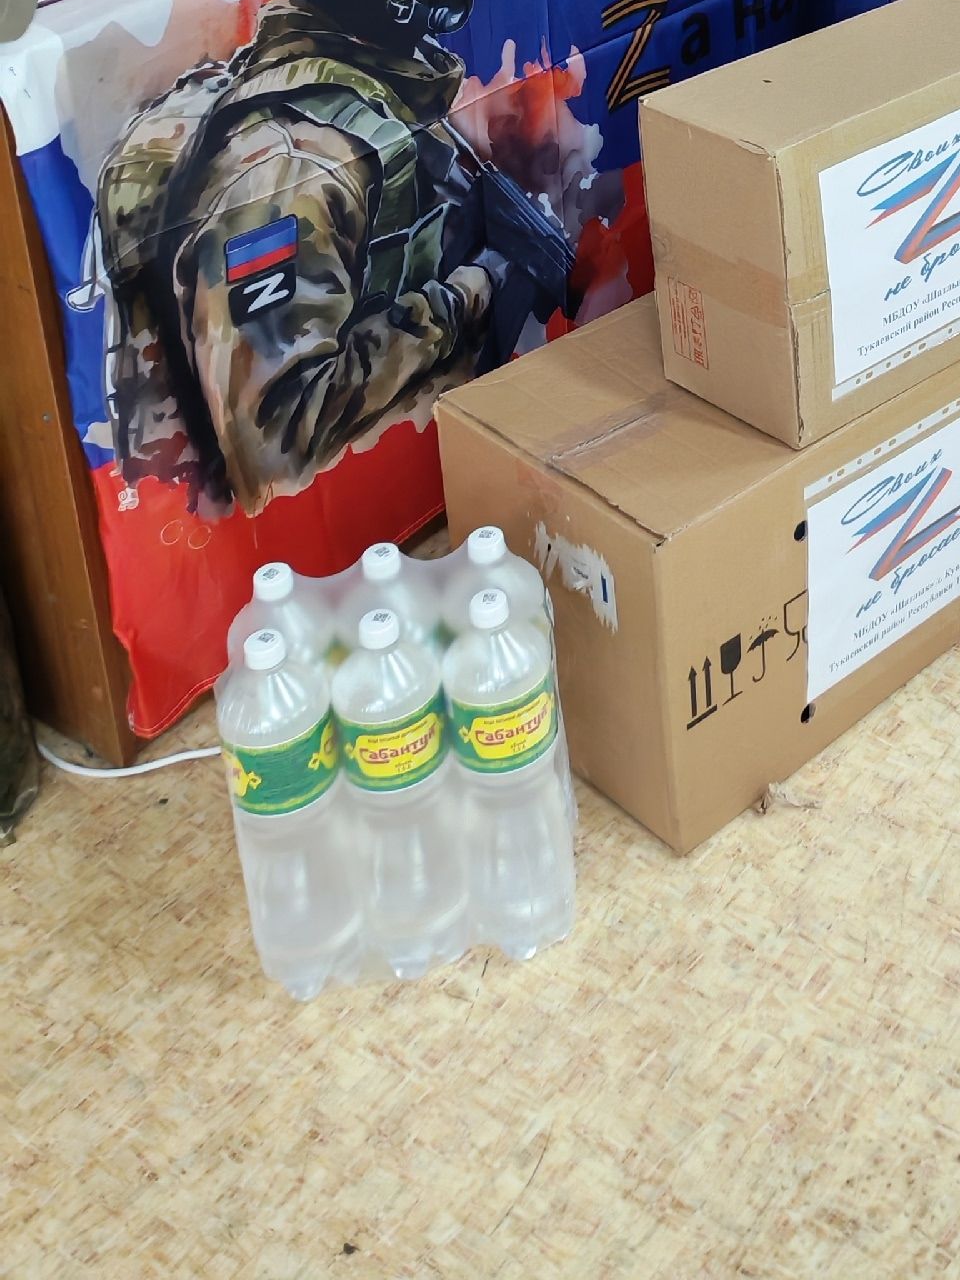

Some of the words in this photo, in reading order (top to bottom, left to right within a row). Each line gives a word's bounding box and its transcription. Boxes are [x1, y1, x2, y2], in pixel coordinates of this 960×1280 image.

[884, 274, 912, 302] не
[882, 299, 920, 327] МБДОУ
[857, 324, 912, 357] Тукаевский
[913, 307, 939, 330] район
[841, 448, 943, 525] Своих
[856, 591, 882, 618] не
